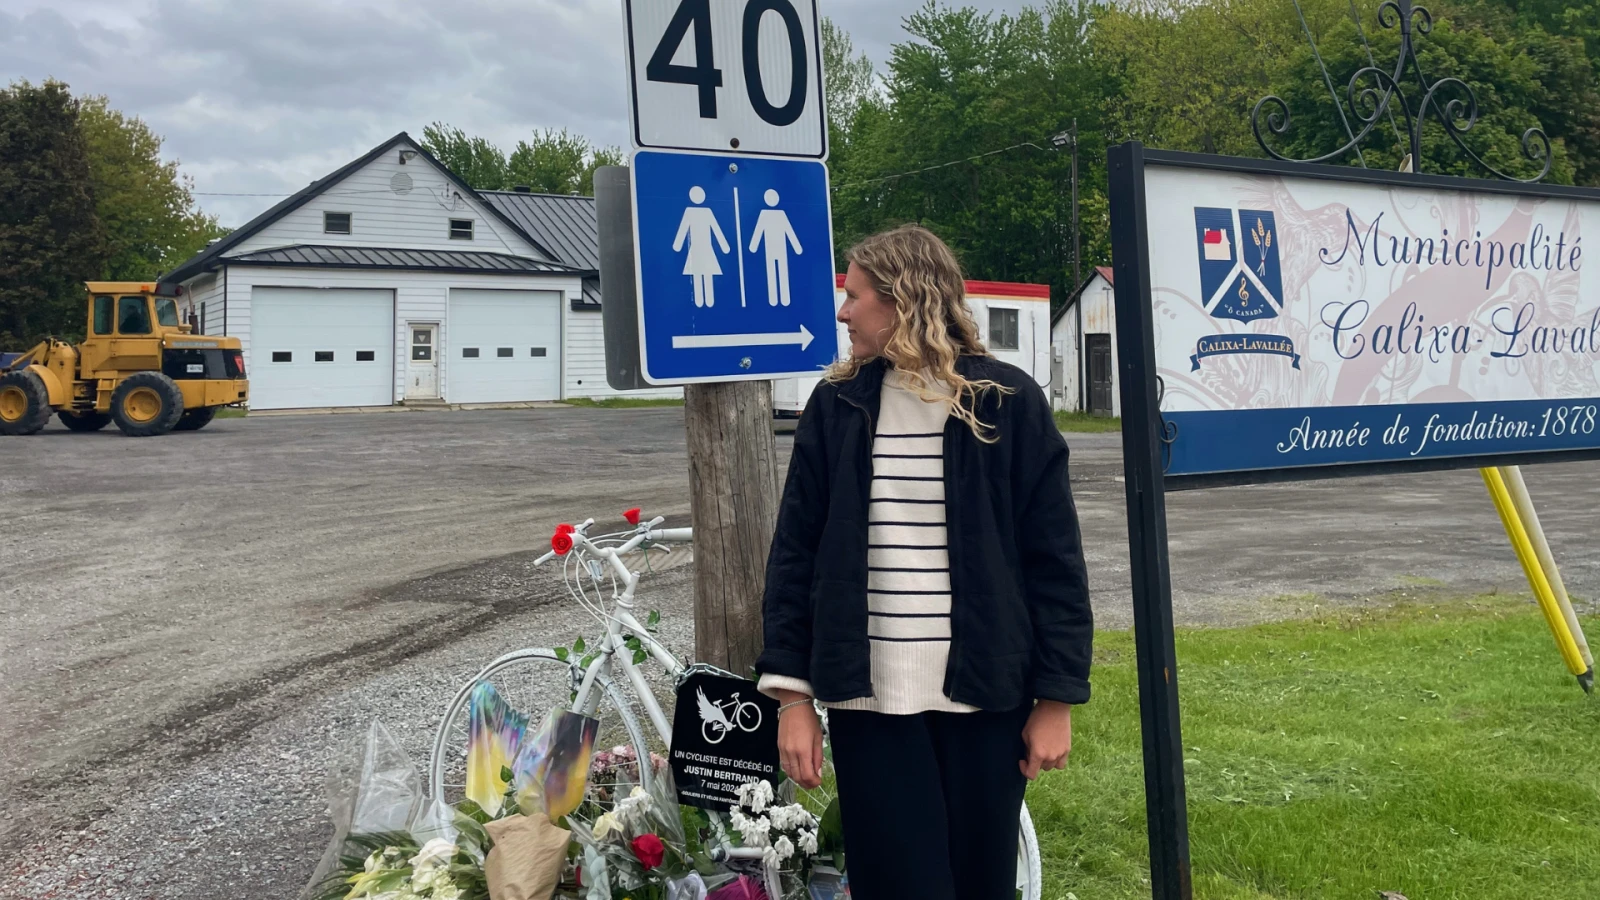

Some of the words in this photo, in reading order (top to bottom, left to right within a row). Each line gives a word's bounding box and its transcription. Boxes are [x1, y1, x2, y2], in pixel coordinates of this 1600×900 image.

[646, 0, 808, 127] 40
[1318, 207, 1582, 290] Municipalité
[1320, 299, 1600, 363] Calixa-Laval
[1276, 415, 1371, 453] Année
[1382, 413, 1408, 444] de
[674, 750, 685, 758] UN
[685, 752, 718, 764] CYCLISTE
[718, 757, 733, 766] EST
[733, 758, 762, 772] DÉCÉDÉ
[763, 764, 774, 773] ICI
[684, 764, 713, 777] JUSTIN
[714, 769, 760, 785] BERTRAND
[701, 779, 706, 787] 7
[706, 781, 720, 790] mai
[721, 783, 741, 793] 2024
